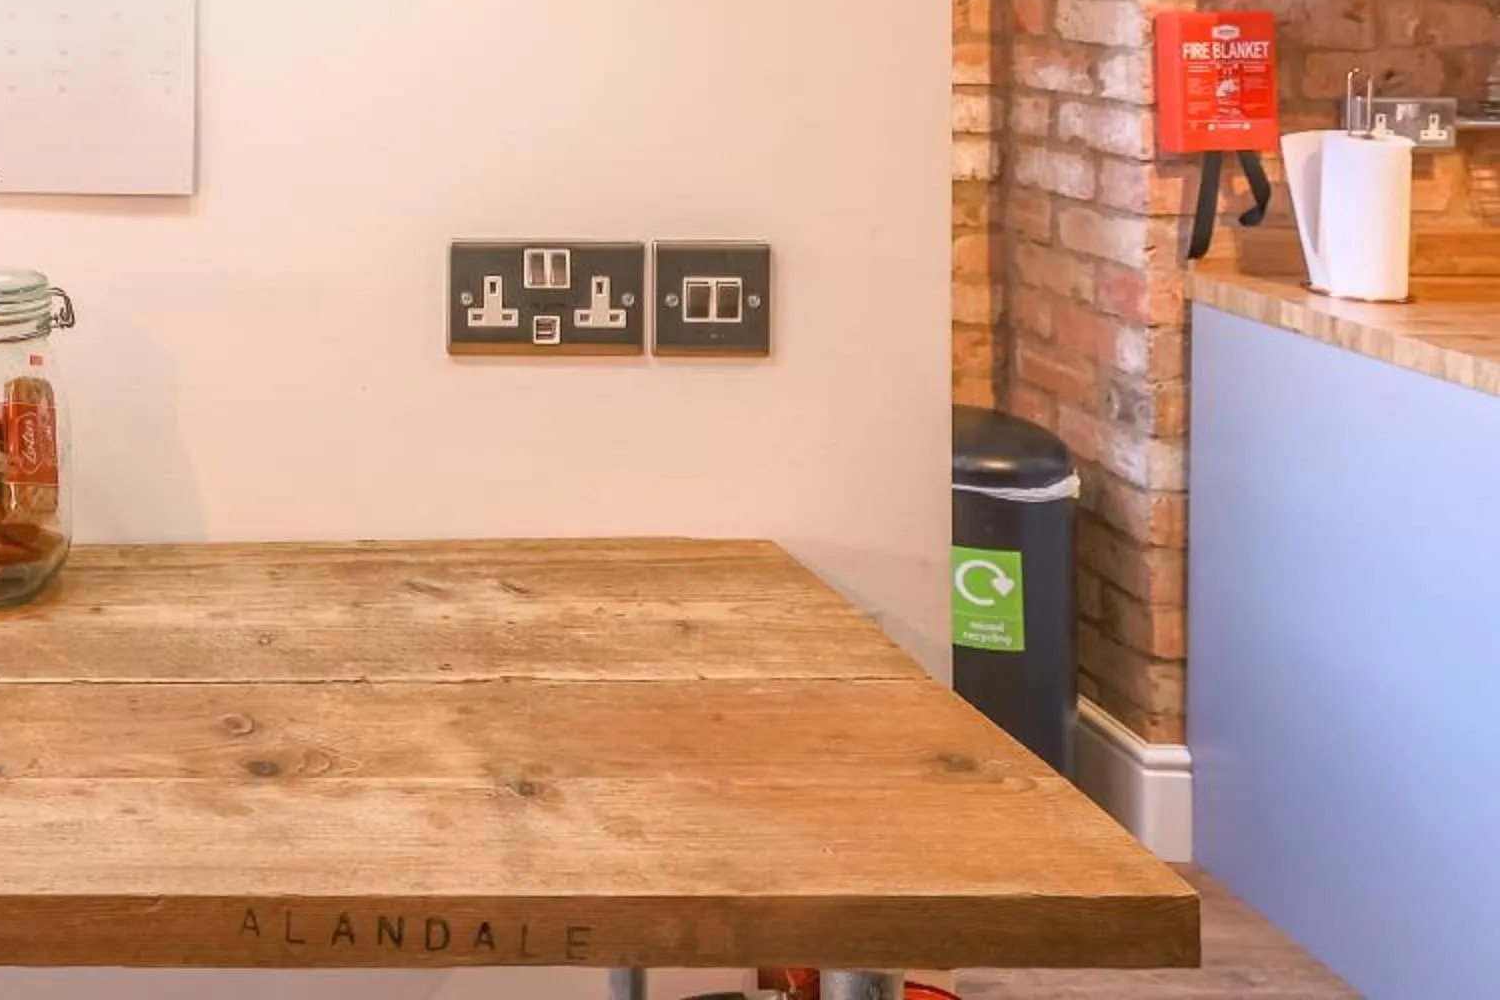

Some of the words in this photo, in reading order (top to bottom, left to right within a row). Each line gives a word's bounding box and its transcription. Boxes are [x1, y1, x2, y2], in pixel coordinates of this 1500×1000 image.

[1182, 41, 1211, 59] FIRE
[1212, 41, 1269, 59] BLANKET
[240, 908, 593, 960] ALANDALE
